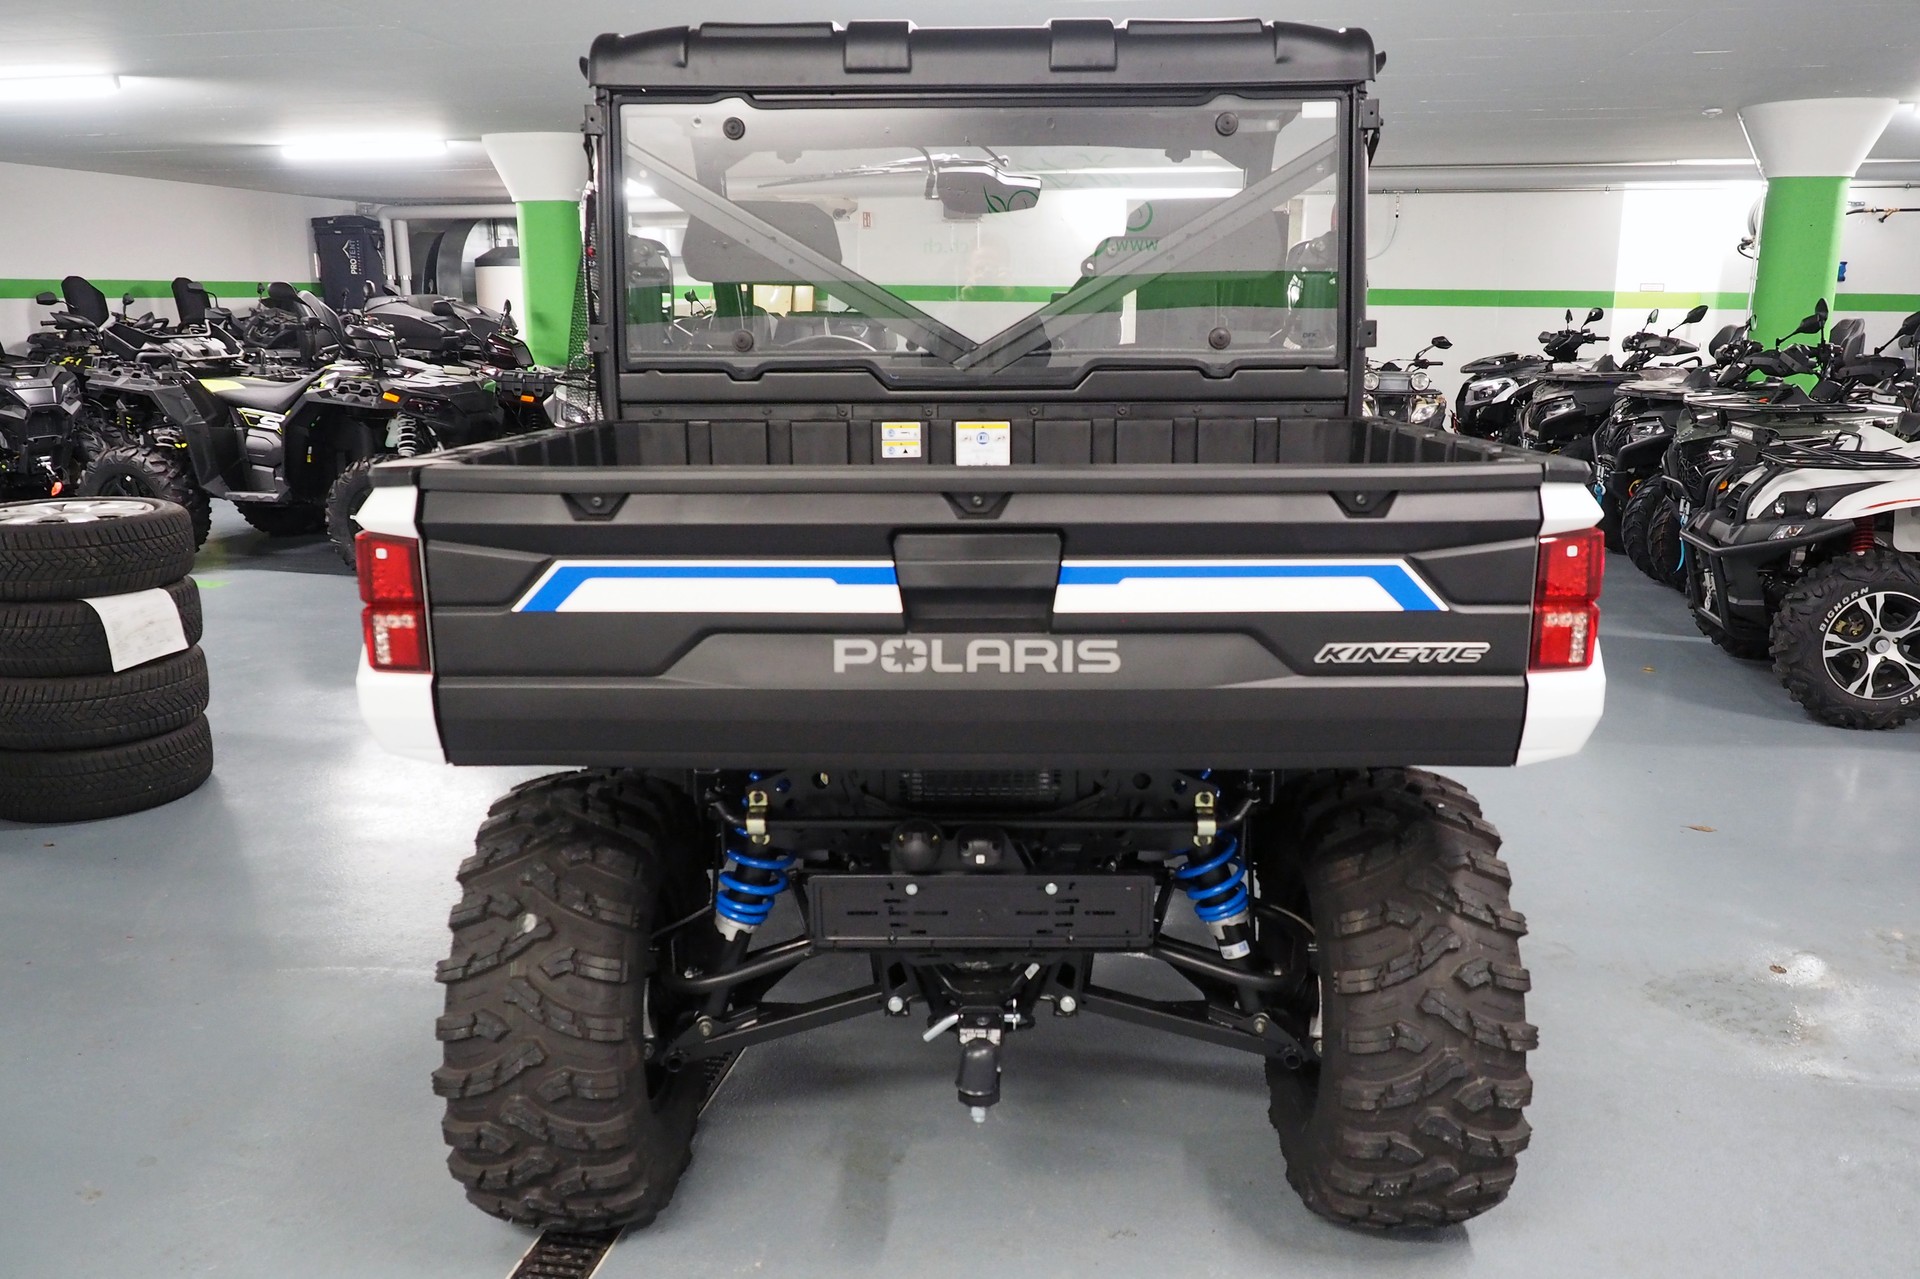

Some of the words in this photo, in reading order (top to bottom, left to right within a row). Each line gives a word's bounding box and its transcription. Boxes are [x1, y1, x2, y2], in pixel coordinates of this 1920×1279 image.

[349, 240, 358, 275] PROTENT
[1819, 586, 1869, 632] BIGHORN
[833, 638, 1122, 674] POLARIS
[1313, 641, 1491, 664] KINETIC
